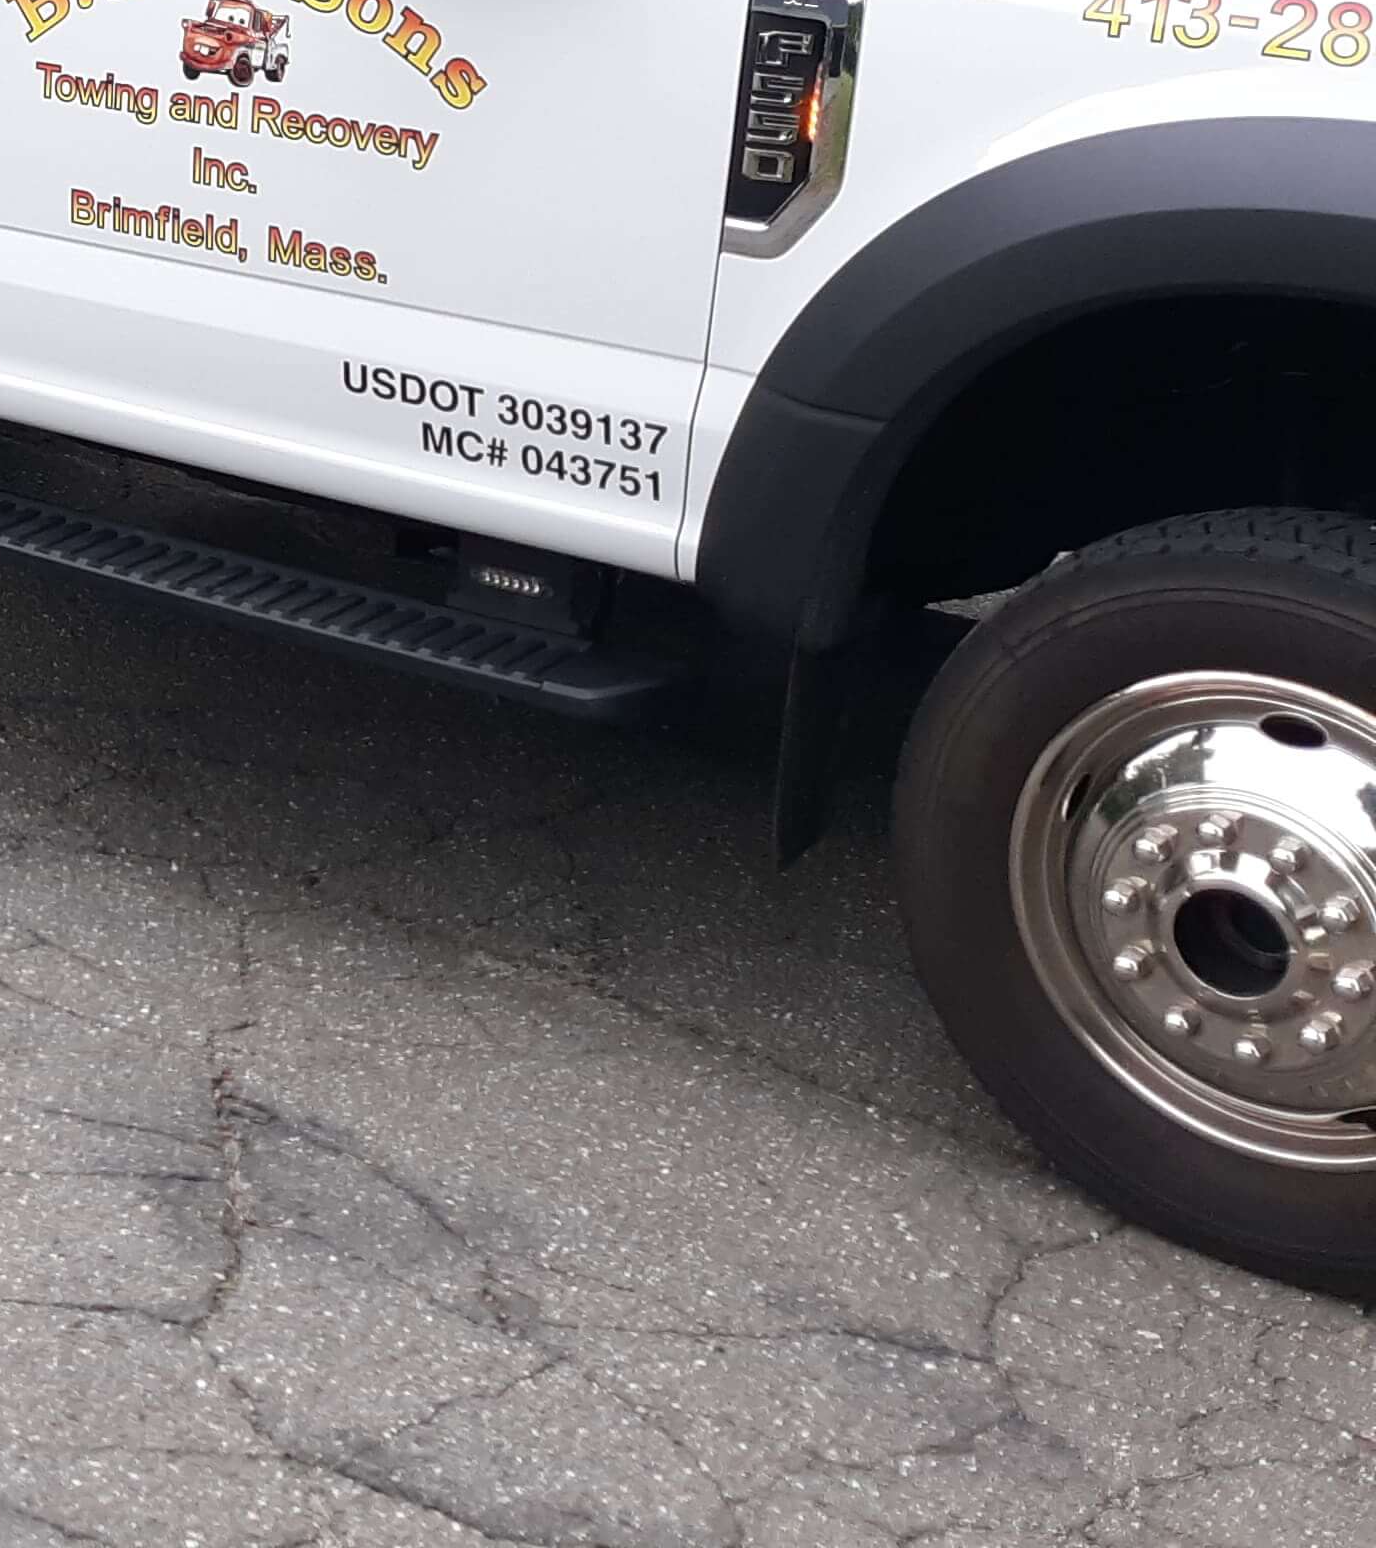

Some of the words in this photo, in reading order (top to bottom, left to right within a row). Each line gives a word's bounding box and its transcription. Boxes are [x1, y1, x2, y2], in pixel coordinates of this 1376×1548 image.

[36, 62, 158, 123] Towing
[169, 91, 239, 129] and
[251, 97, 439, 170] Recovery
[192, 147, 258, 194] Inc.
[69, 189, 248, 262] Brimfield,
[267, 226, 388, 284] Mass.
[343, 360, 484, 417] USDOT
[498, 394, 668, 455] 3039137
[422, 422, 508, 468] MC#
[522, 445, 661, 502] 043751
